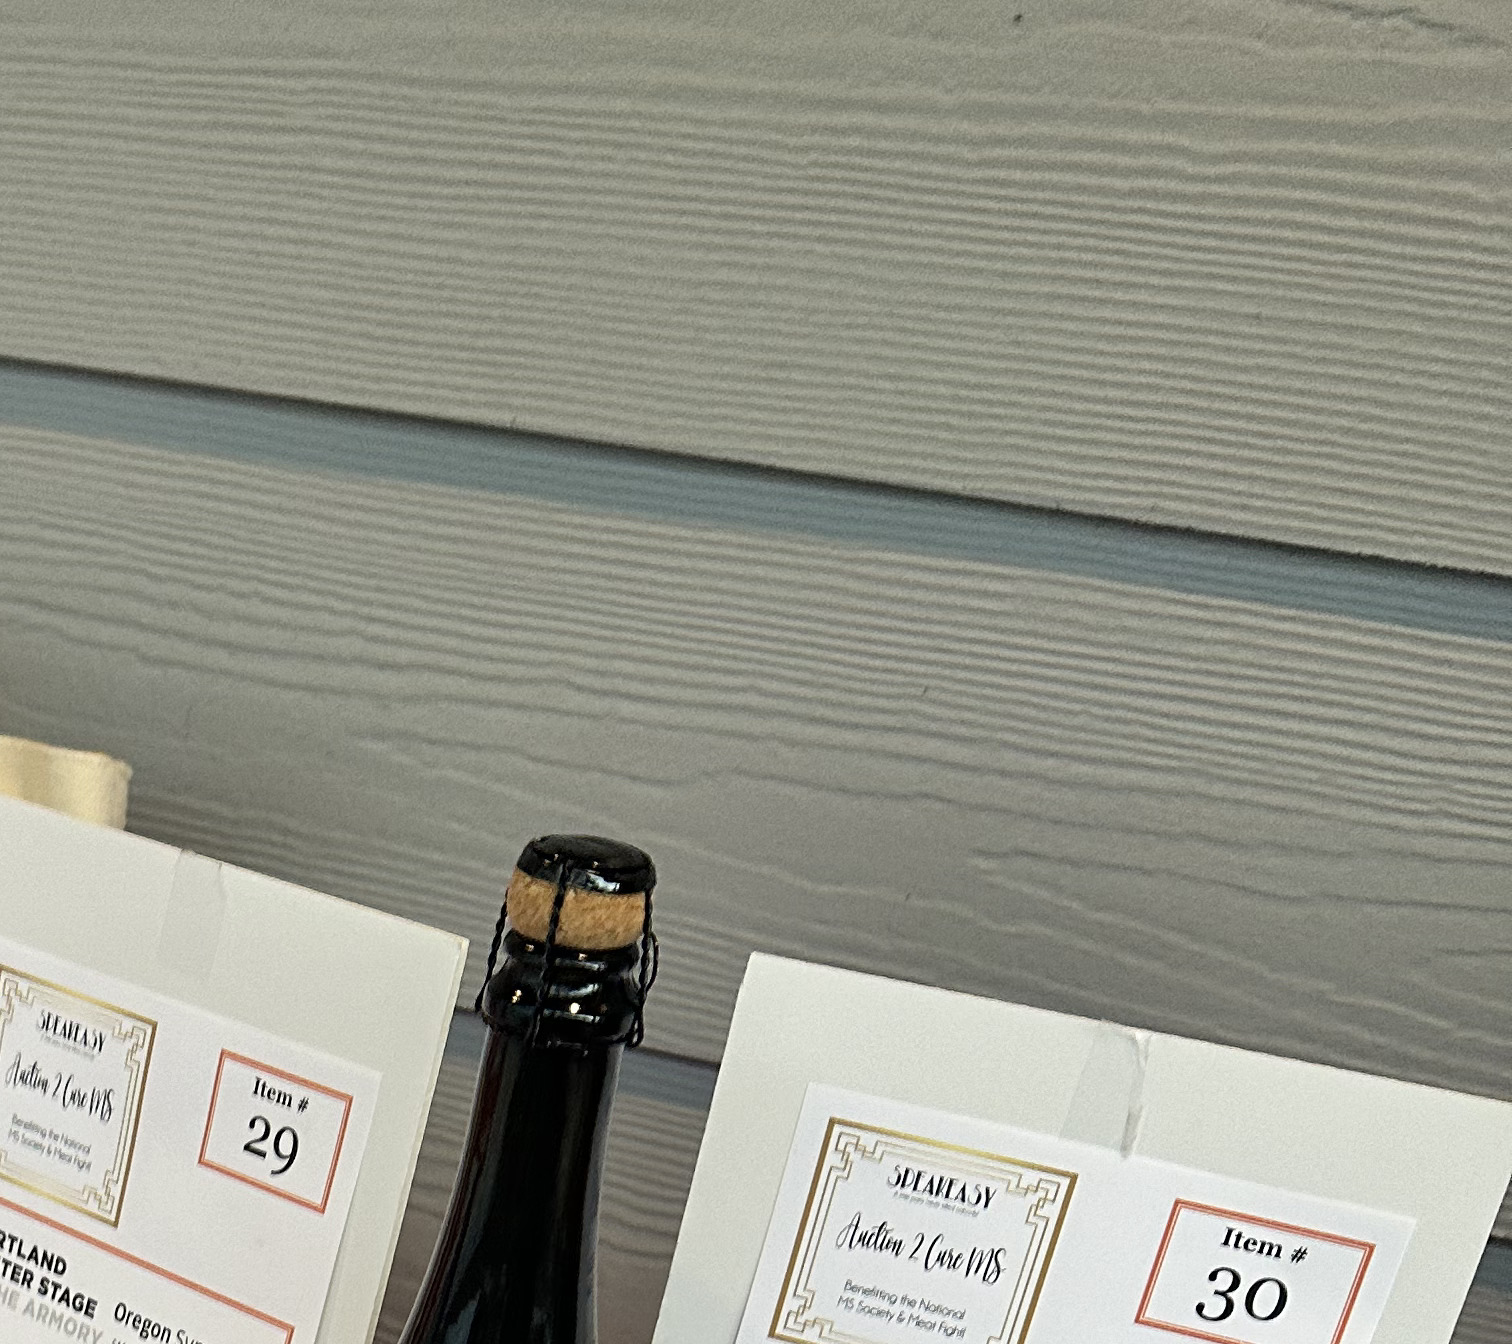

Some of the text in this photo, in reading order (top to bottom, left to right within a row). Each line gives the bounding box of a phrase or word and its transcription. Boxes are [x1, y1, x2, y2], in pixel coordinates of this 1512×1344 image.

[253, 1076, 309, 1113] Item #
[243, 1115, 299, 1175] 29
[886, 1163, 998, 1210] SPEAKEASY
[908, 1232, 925, 1259] 2
[965, 1245, 1007, 1285] MS
[1221, 1226, 1308, 1264] Item #
[37, 1276, 98, 1320] STAGE
[1195, 1266, 1288, 1322] 30
[114, 1302, 172, 1344] Oregon
